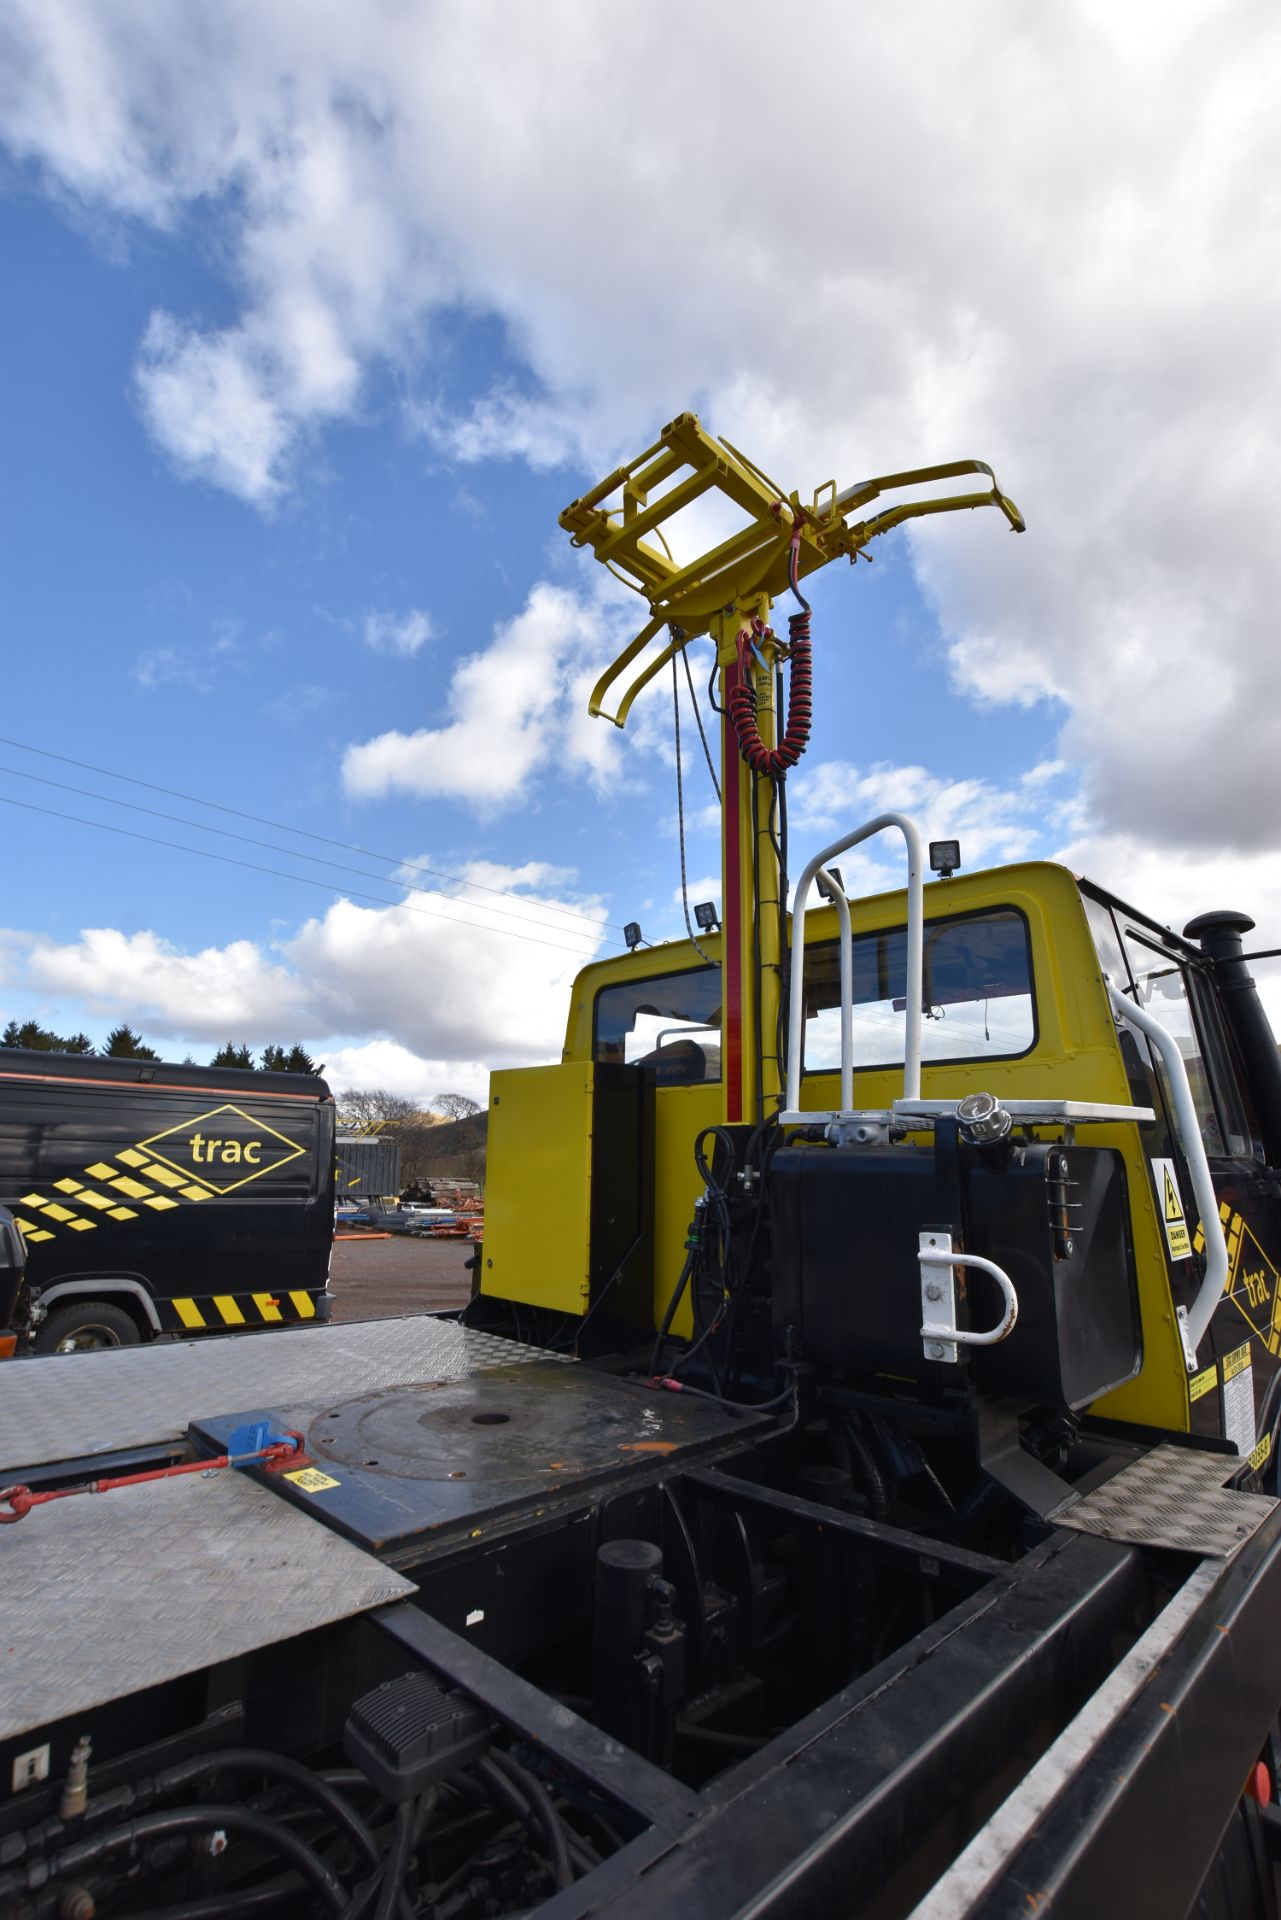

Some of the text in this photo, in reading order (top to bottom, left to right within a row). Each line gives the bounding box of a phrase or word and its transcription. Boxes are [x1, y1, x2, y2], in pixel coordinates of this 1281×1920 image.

[189, 1133, 262, 1164] trac
[1170, 1229, 1186, 1241] DANGER
[1243, 1267, 1270, 1308] trac
